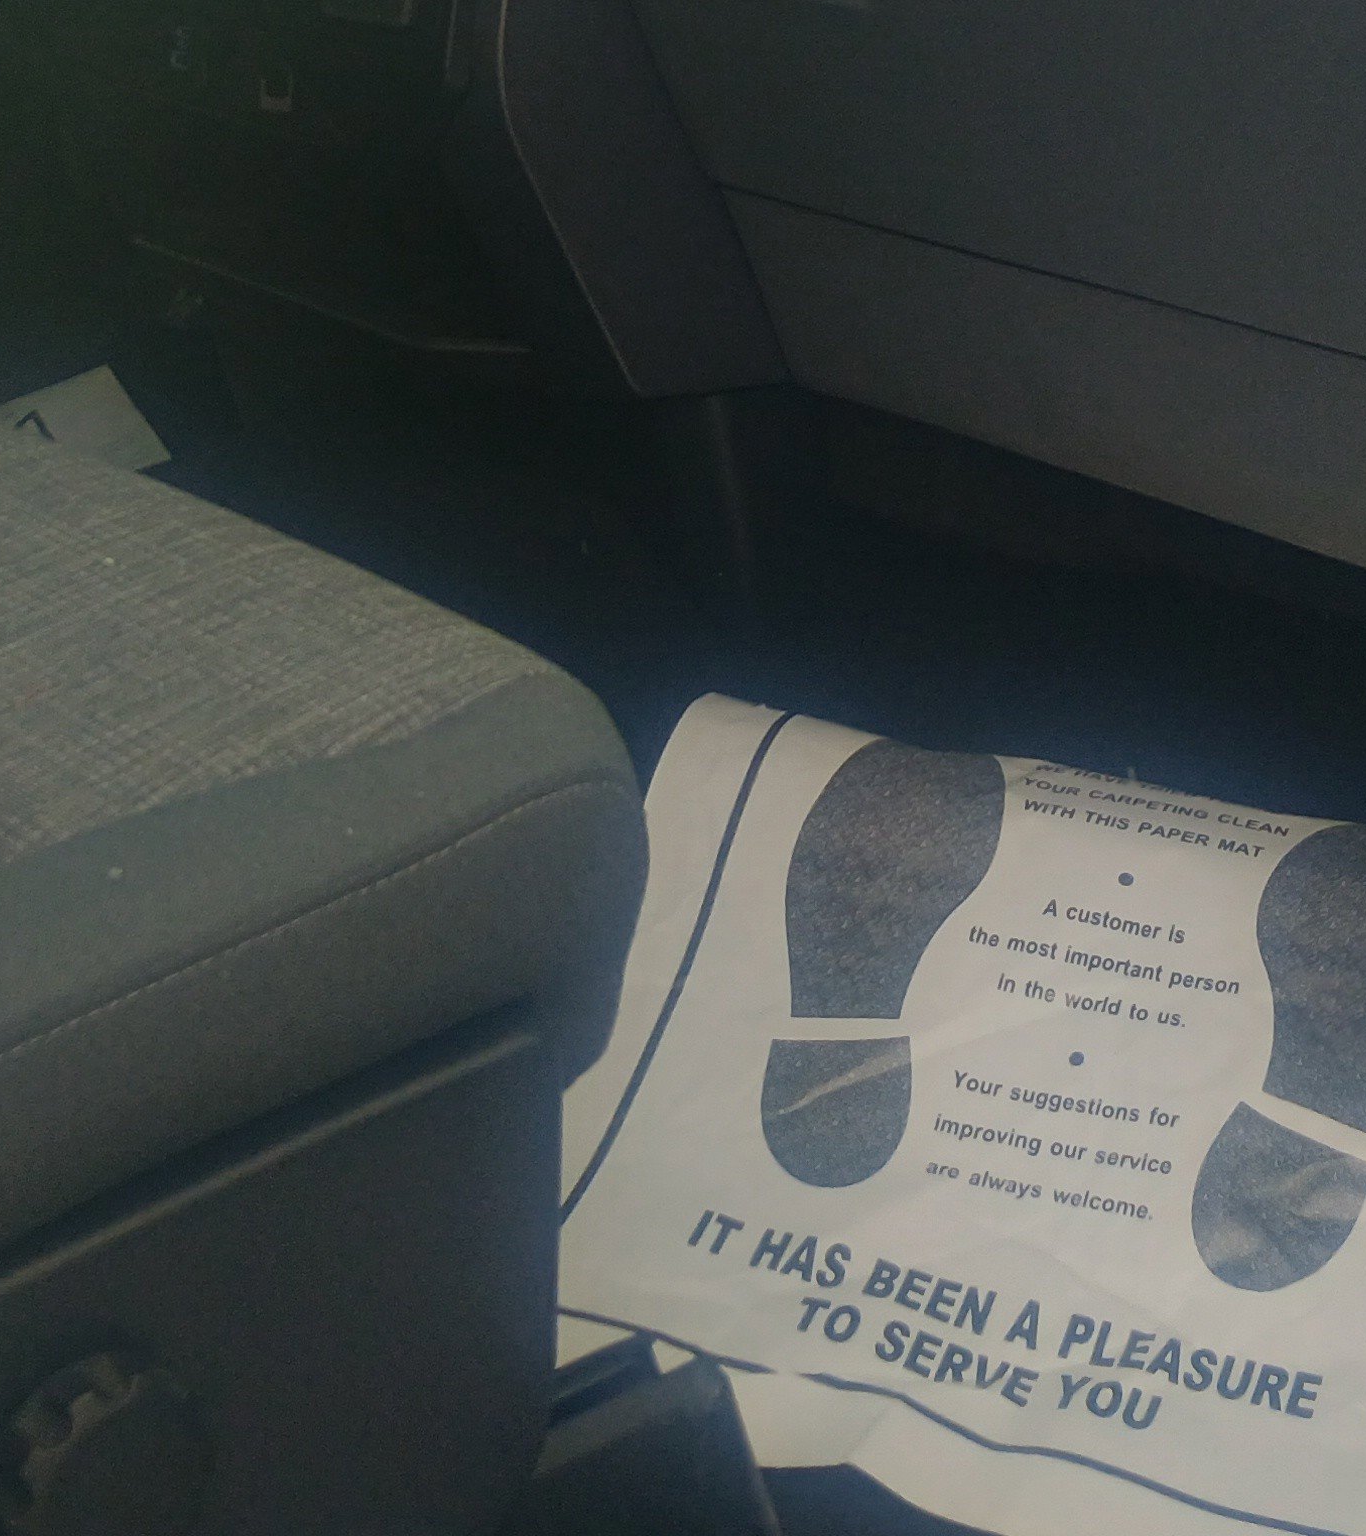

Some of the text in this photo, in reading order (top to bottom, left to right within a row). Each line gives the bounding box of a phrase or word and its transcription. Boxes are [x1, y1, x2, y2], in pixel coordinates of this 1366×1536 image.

[1023, 798, 1265, 858] WITH THIS PAPER MAT
[1024, 777, 1081, 797] YOUR
[1088, 789, 1209, 820] CARPETING
[1217, 813, 1290, 837] CLEAN
[1041, 898, 1057, 917] A
[1065, 906, 1162, 940] customer
[968, 925, 1240, 995] the most important person
[1024, 980, 1056, 1003] the
[1064, 992, 1122, 1016] world
[1129, 1004, 1149, 1022] to
[1157, 1011, 1186, 1028] us.
[953, 1070, 1180, 1128] Your suggestions for
[933, 1113, 1173, 1175] improving our service
[925, 1161, 1153, 1221] are always welcome.
[687, 1209, 1325, 1420] IT HAS BEEN A PLEASURE
[793, 1296, 1163, 1431] TO SERVE YOU
